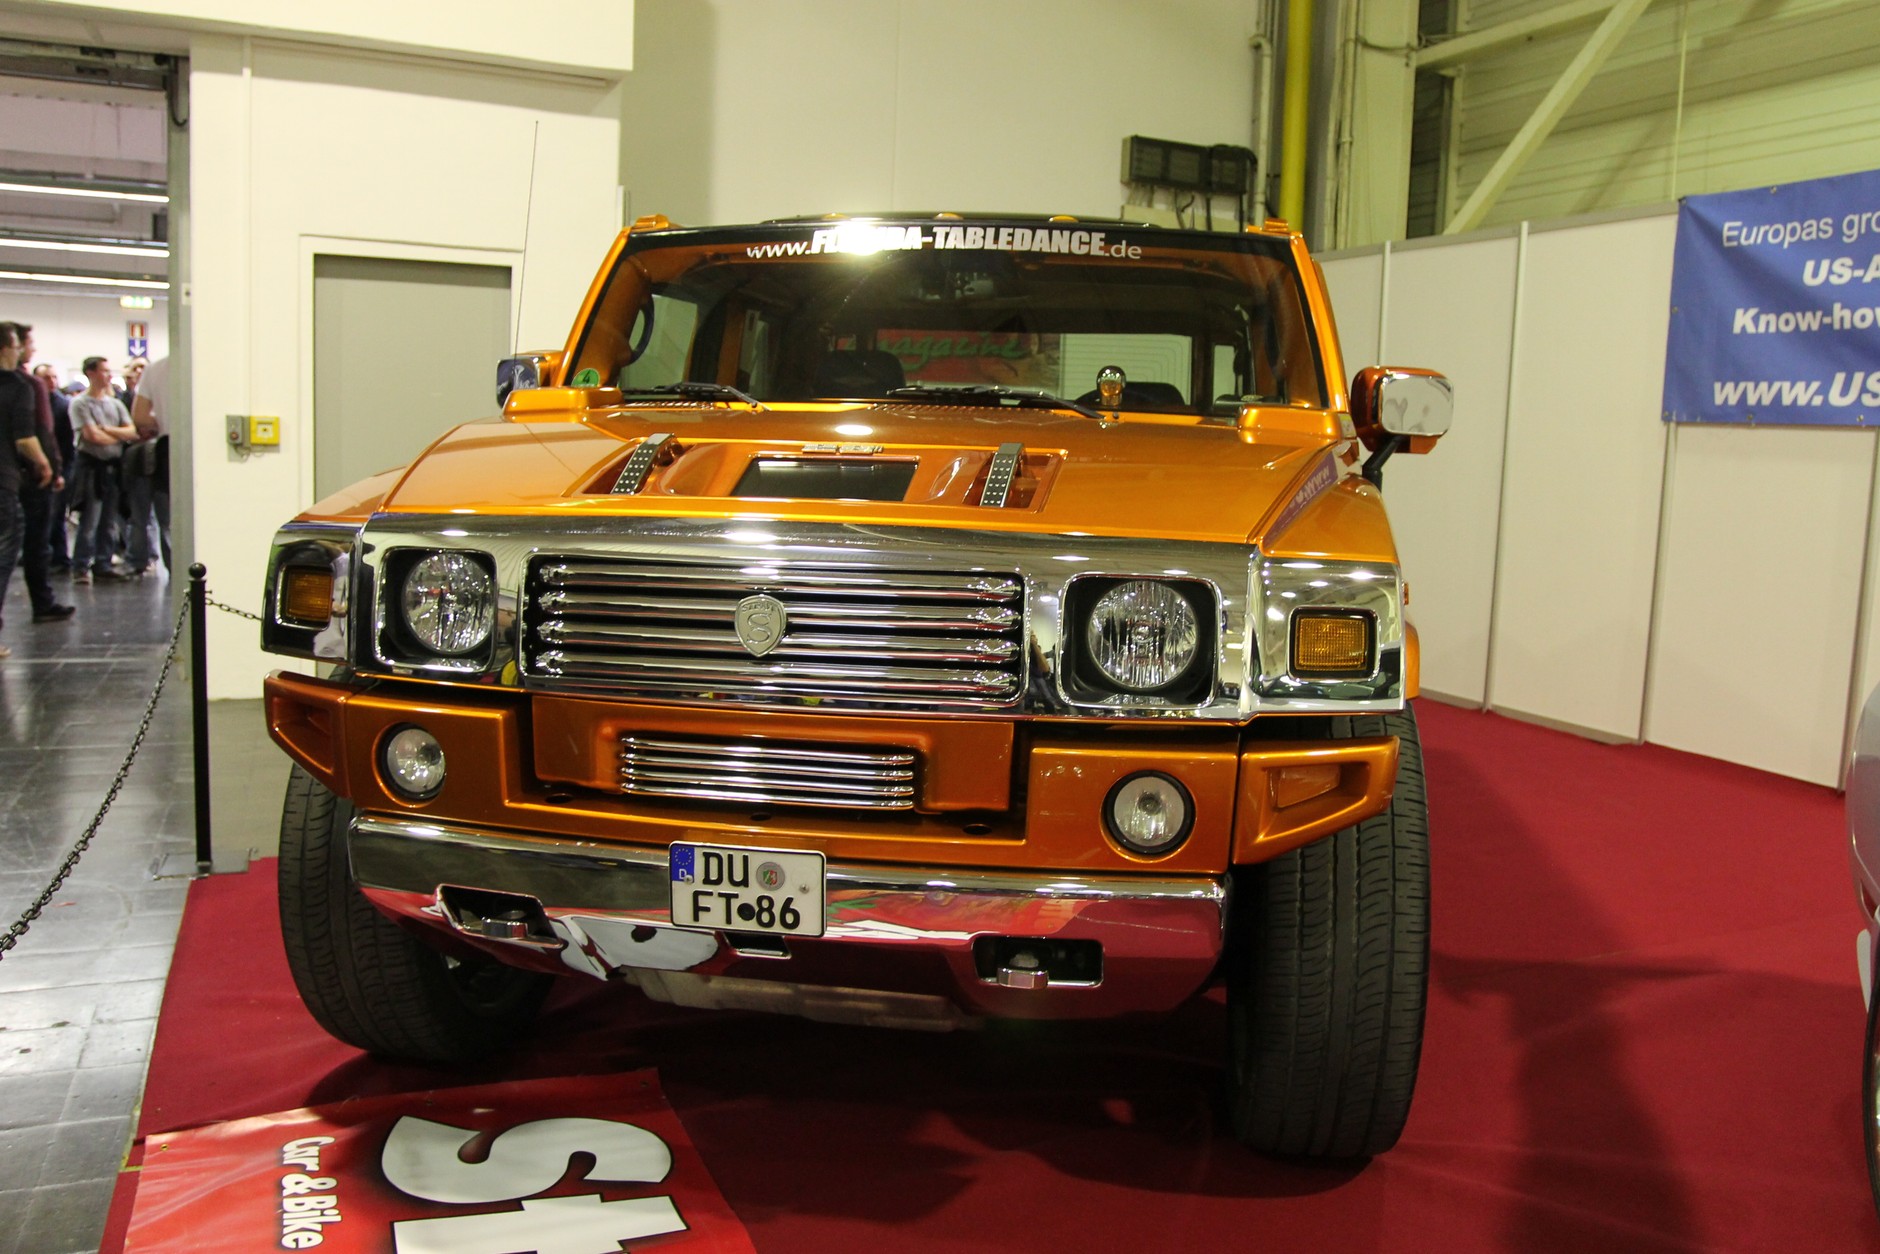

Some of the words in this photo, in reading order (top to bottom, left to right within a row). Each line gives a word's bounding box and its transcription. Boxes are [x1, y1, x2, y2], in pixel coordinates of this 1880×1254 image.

[1722, 217, 1834, 249] Europas
[1732, 303, 1880, 334] Know-ho
[702, 851, 749, 888] DU
[282, 1136, 336, 1172] Car
